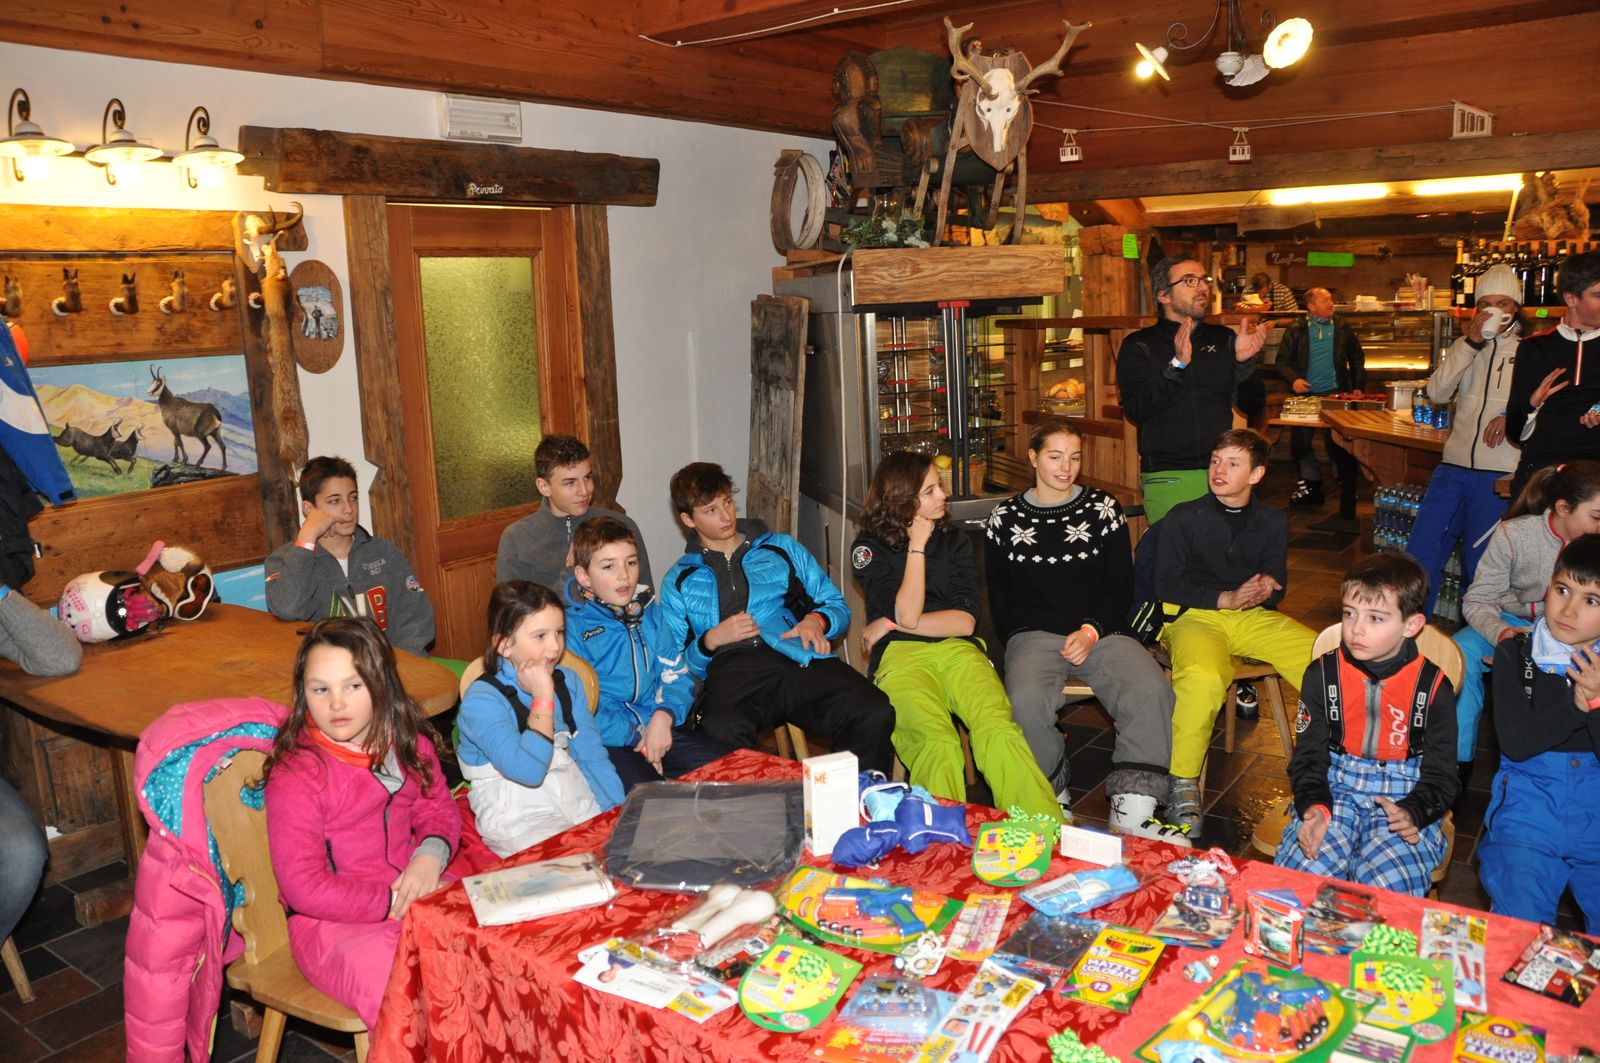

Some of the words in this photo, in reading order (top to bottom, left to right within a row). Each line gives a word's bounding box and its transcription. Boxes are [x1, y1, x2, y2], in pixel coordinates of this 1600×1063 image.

[468, 182, 504, 196] Privato
[1328, 684, 1339, 720] DKB
[1413, 691, 1427, 728] DKB
[1093, 983, 1108, 993] 12
